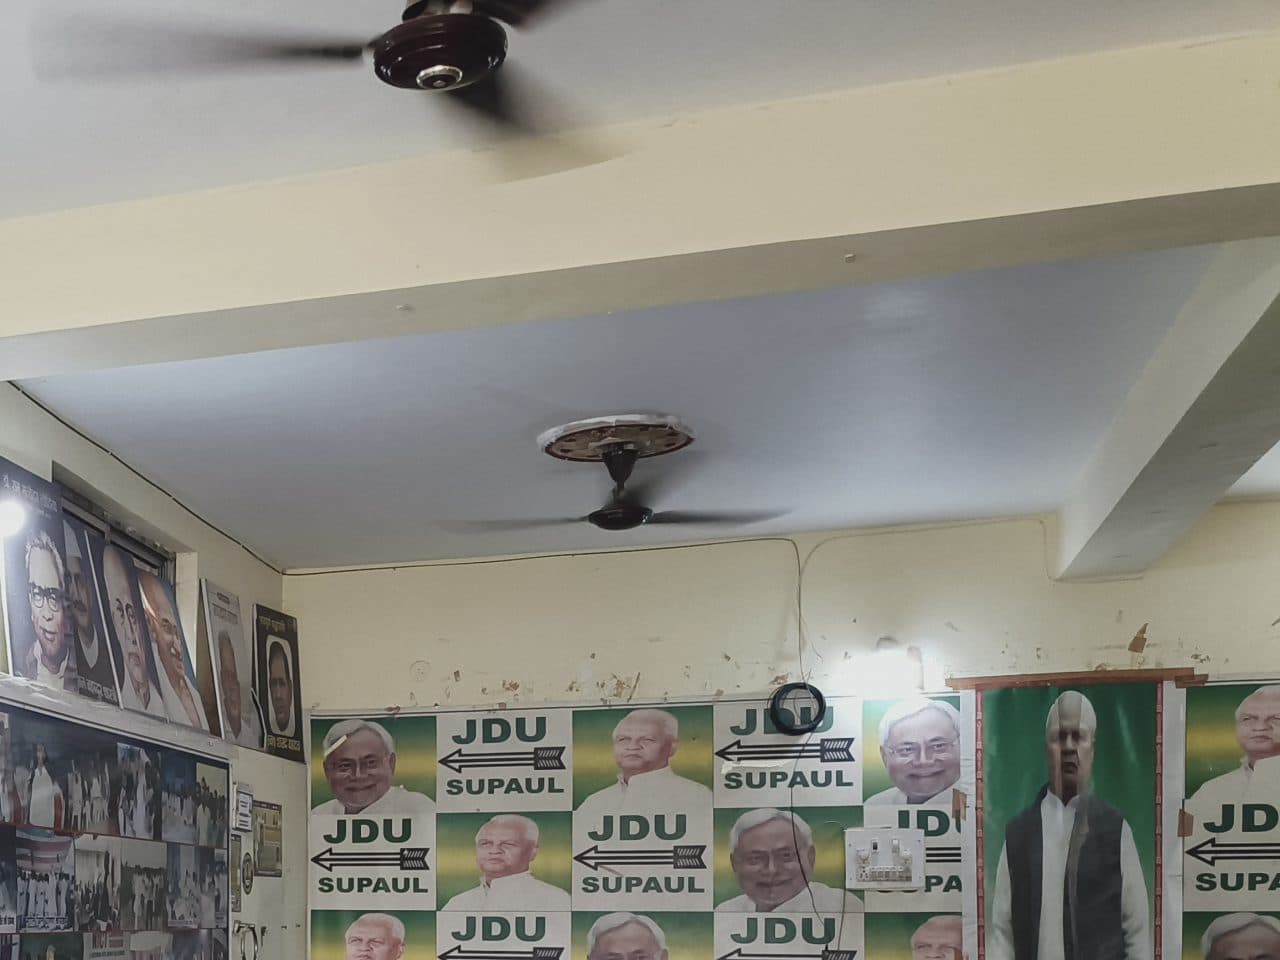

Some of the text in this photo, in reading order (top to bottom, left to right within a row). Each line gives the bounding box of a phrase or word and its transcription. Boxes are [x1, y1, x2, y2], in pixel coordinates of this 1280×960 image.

[452, 716, 546, 744] JDU
[730, 706, 833, 735] JDU
[446, 776, 564, 795] SUPAUL
[724, 770, 853, 789] SUPAUL
[323, 818, 412, 844] JDU
[588, 813, 686, 841] JDU
[318, 877, 428, 894] SUPAUL
[582, 876, 704, 893] SUPAUL
[452, 916, 546, 942] JDU
[731, 917, 836, 944] JDU
